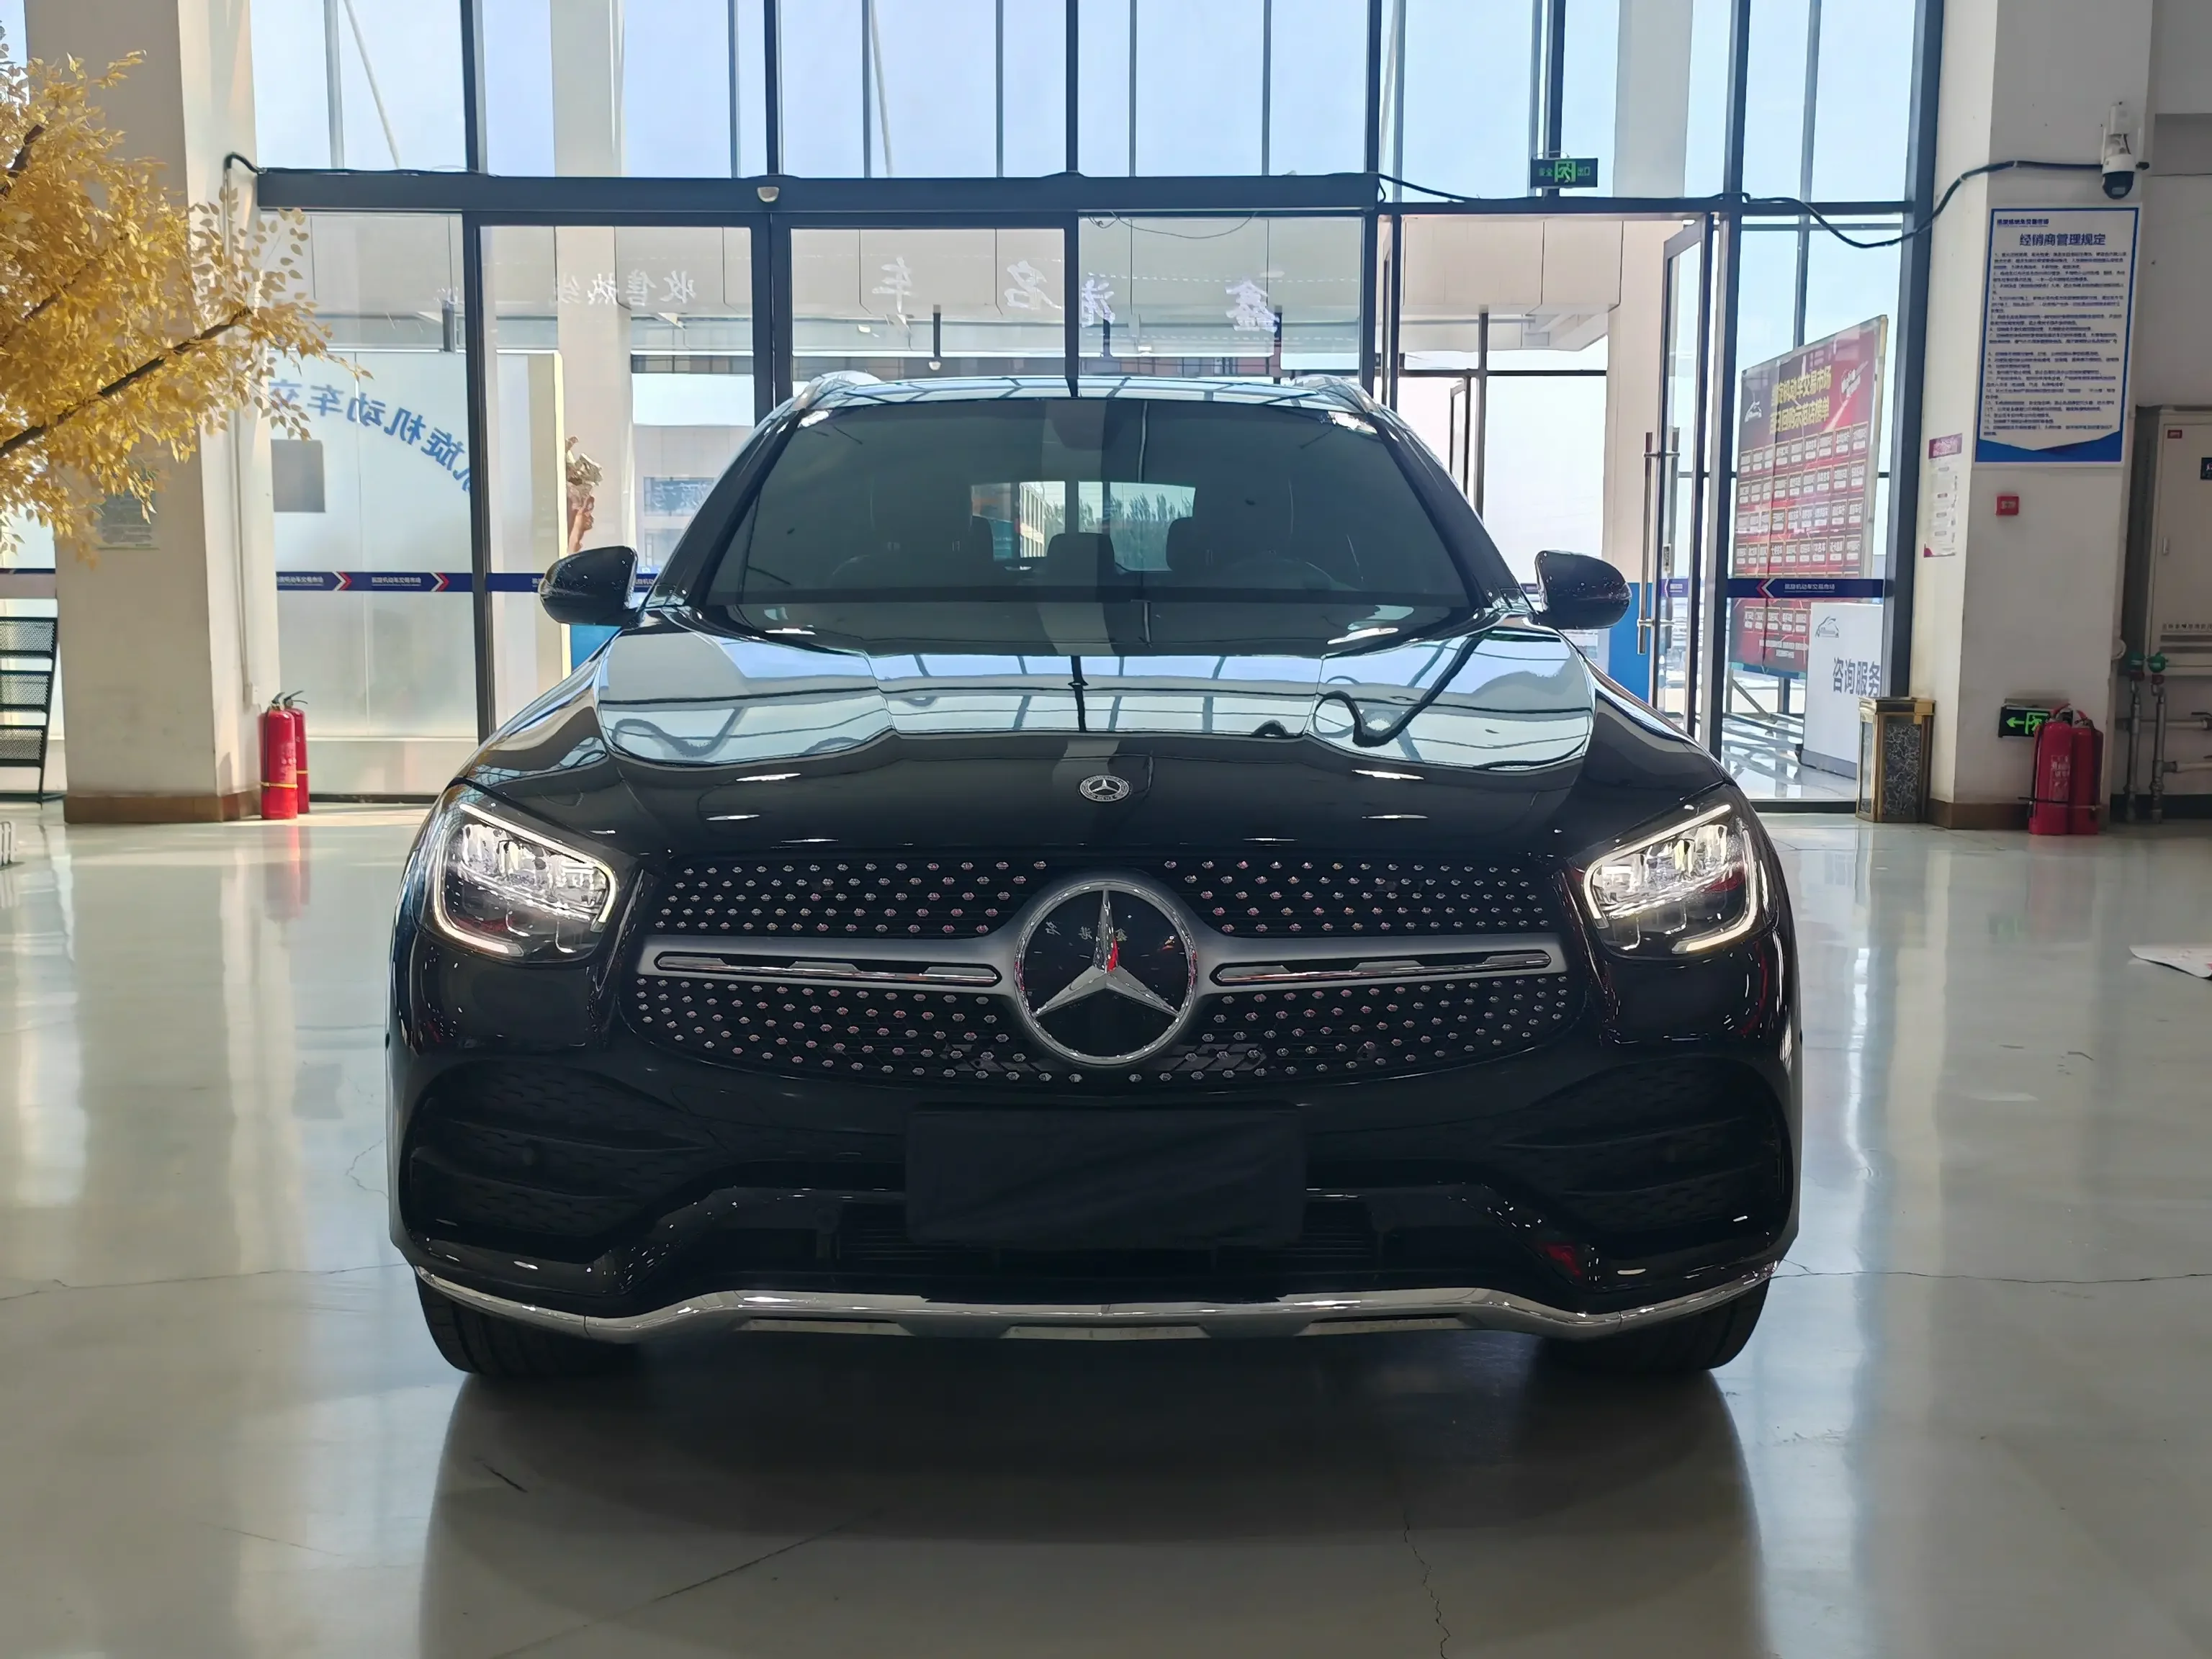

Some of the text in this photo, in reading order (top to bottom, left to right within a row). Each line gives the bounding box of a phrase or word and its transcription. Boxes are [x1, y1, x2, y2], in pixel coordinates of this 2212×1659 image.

[2020, 233, 2105, 246] 经销商管理规定
[1833, 656, 1881, 698] 咨询服务
